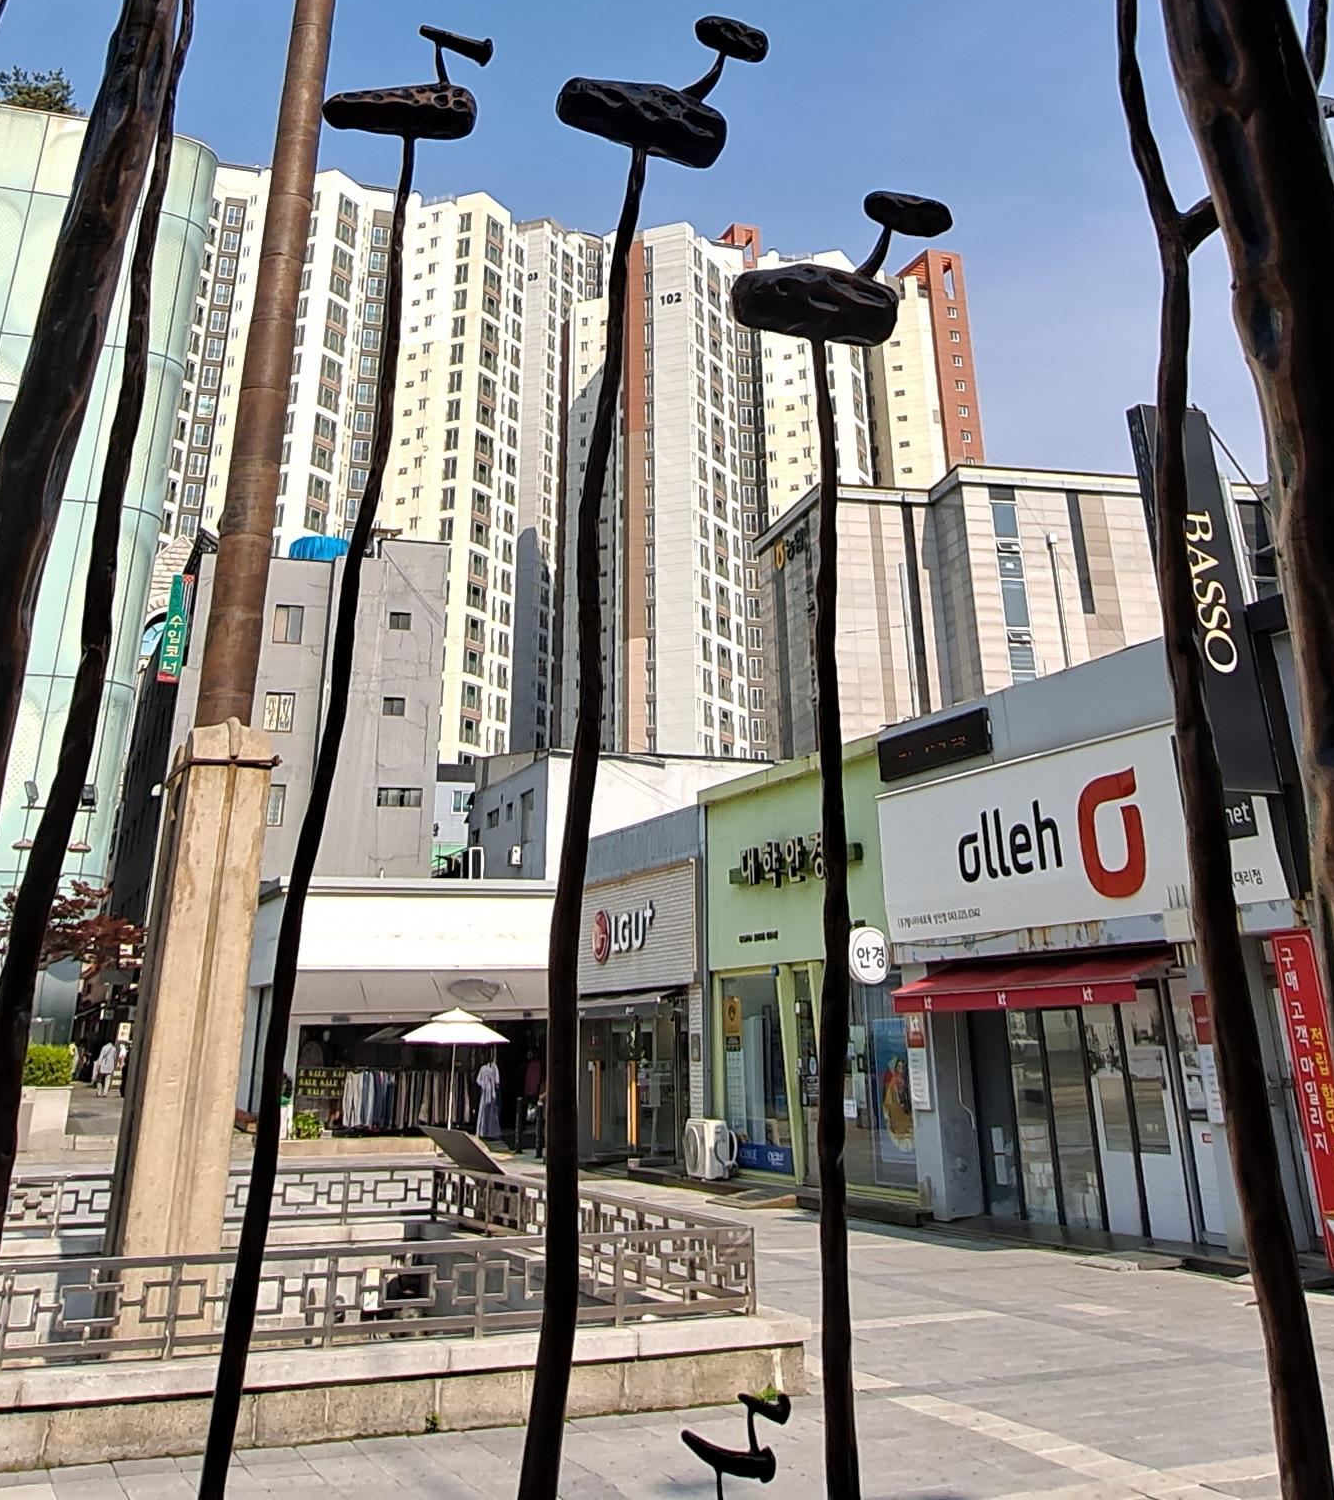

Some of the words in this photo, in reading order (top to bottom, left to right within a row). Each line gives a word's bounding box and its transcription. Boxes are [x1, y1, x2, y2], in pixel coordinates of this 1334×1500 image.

[660, 292, 682, 307] 102
[1186, 509, 1239, 674] BASSO
[162, 614, 185, 675] 수입코너
[958, 799, 1063, 884] olleh
[856, 946, 885, 969] 안경
[1280, 947, 1300, 992] 구매
[924, 996, 933, 1010] kt
[997, 991, 1007, 1006] kt
[1082, 986, 1093, 1002] kt
[1289, 1001, 1310, 1049] 고객
[1310, 1027, 1330, 1077] 적립
[1299, 1055, 1330, 1156] 마일리지
